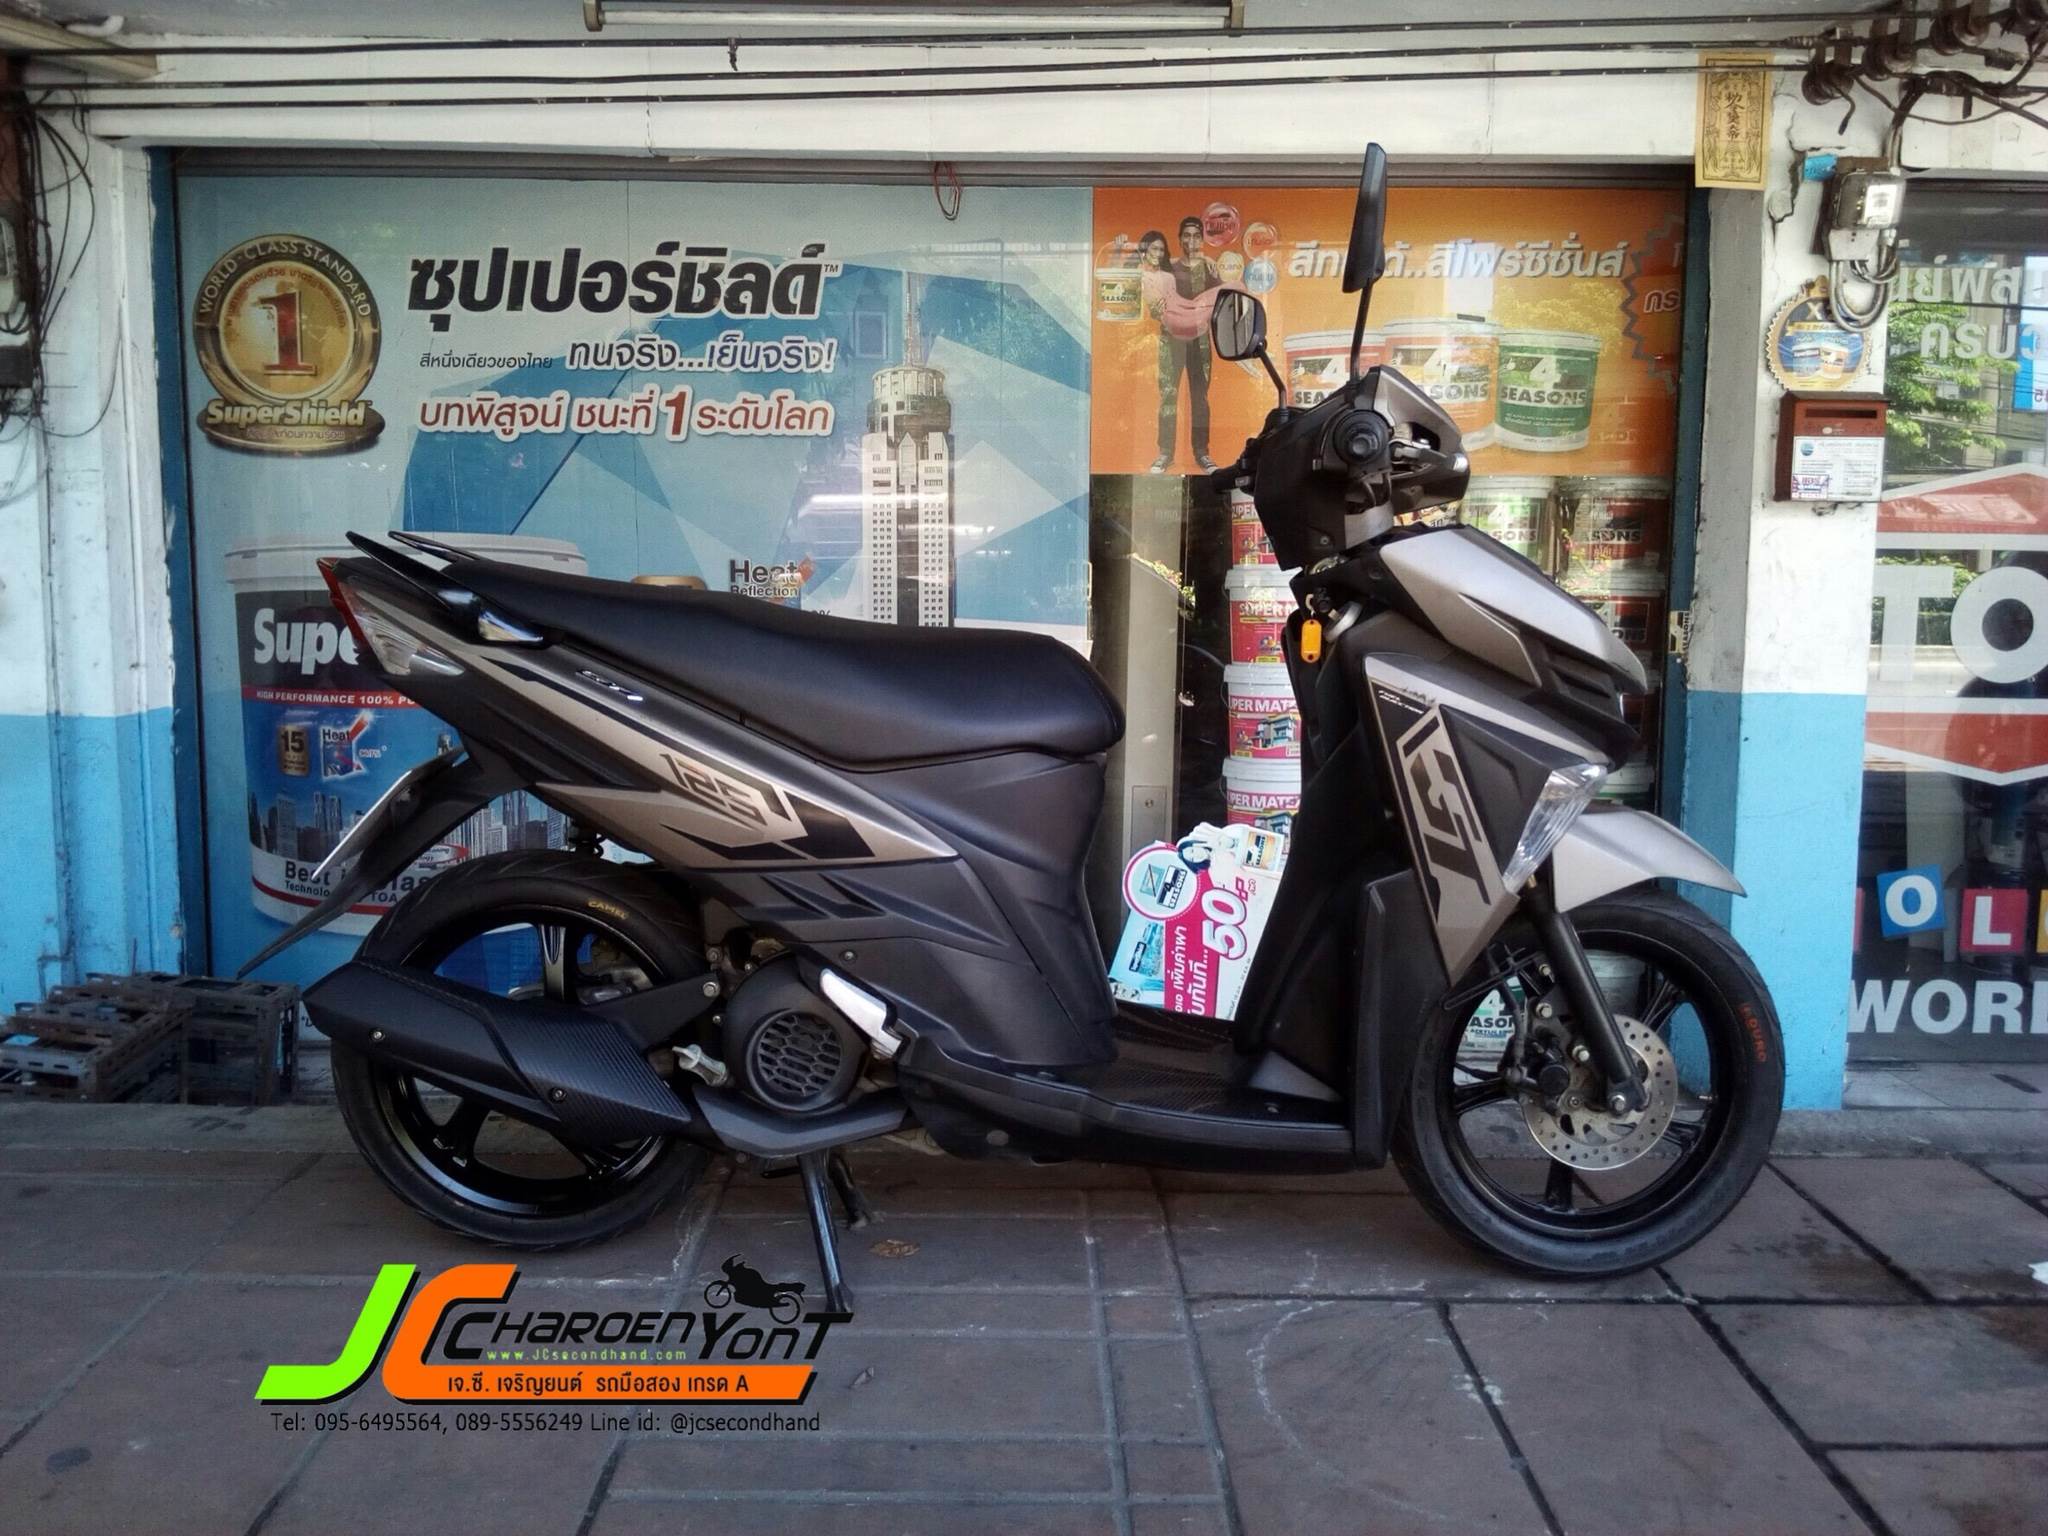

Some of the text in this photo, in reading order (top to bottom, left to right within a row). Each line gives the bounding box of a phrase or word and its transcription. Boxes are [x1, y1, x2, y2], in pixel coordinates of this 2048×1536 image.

[303, 244, 372, 317] STANDARD
[1643, 290, 1680, 313] กร
[257, 290, 318, 376] 1
[419, 349, 553, 369] สีหนึ่งเดียวของไทย
[1529, 356, 1562, 389] 4
[1295, 391, 1330, 405] SEA
[1422, 383, 1489, 401] SONS
[1500, 387, 1587, 406] SEASONS
[207, 400, 367, 428] SuperShield
[420, 390, 830, 436] บทพิสูจน์ ชนะที่ 1 ระดับโลก
[1493, 530, 1537, 541] SONS
[1592, 531, 1641, 541] SONS
[730, 559, 798, 583] Heat
[254, 608, 362, 675] Supe
[275, 691, 355, 704] PERFORMANCE
[359, 695, 394, 705] 100%
[281, 730, 305, 752] 15
[284, 880, 331, 898] Technolo
[1167, 867, 1187, 910] SEASONS
